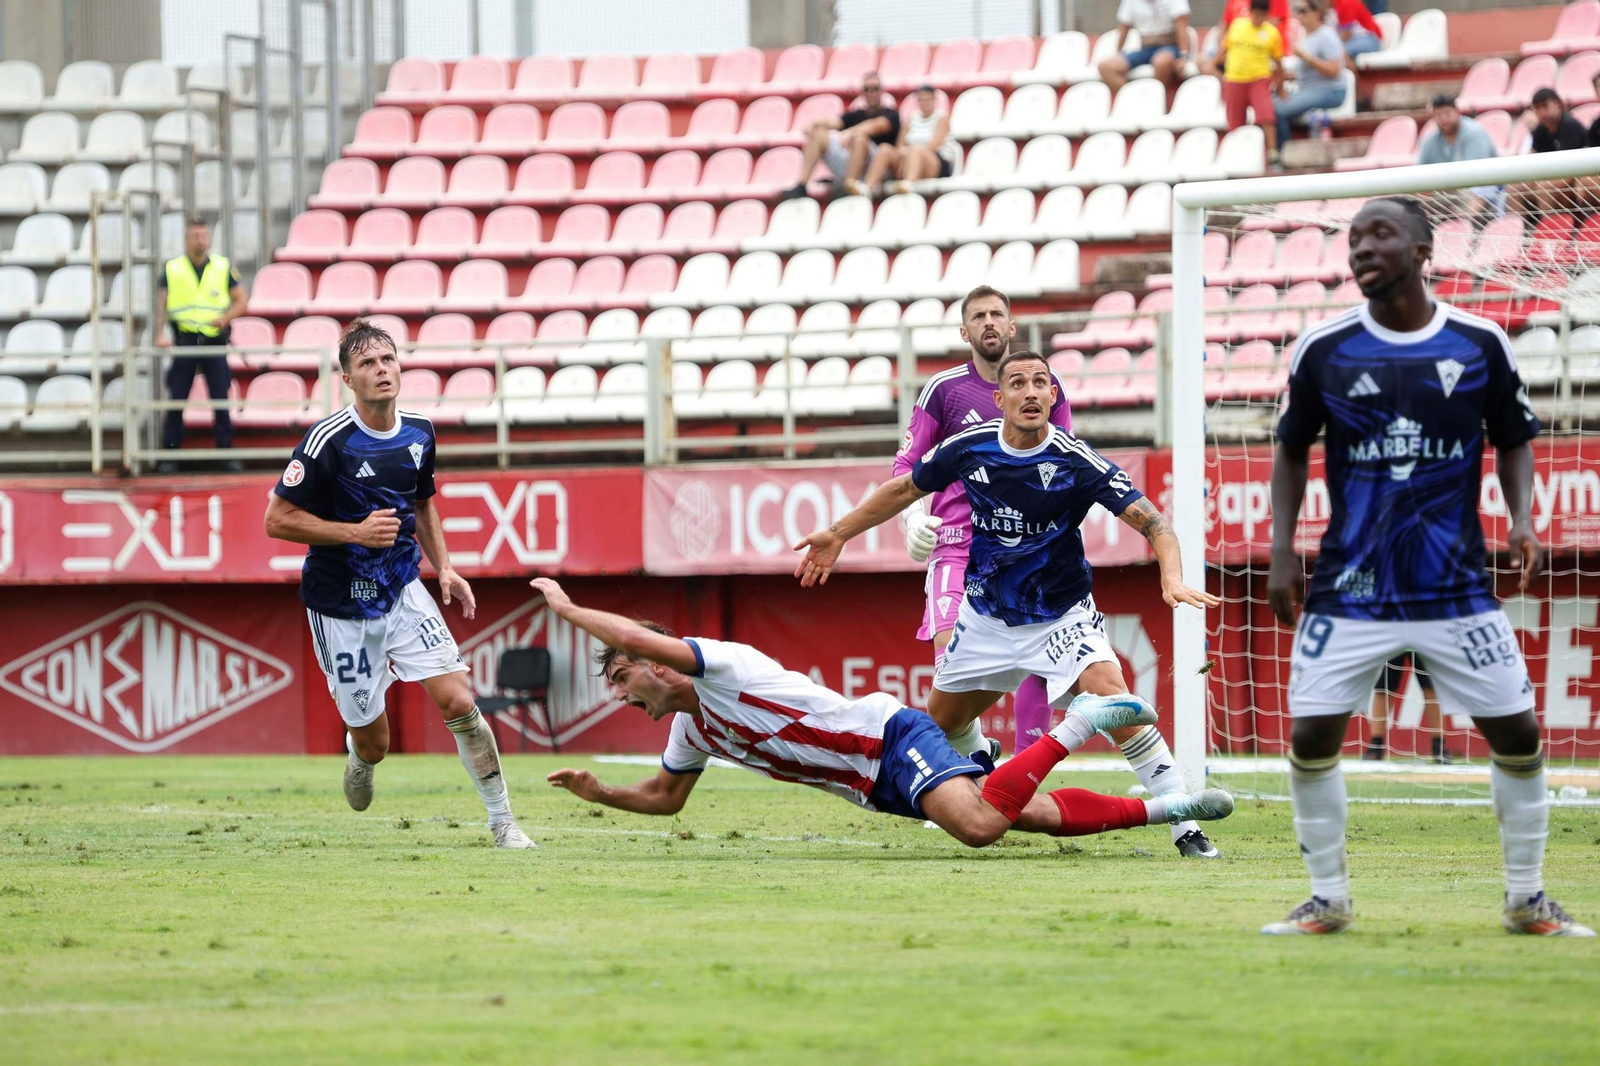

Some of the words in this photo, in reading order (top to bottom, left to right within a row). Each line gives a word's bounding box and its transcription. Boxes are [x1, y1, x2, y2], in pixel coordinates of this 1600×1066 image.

[1349, 436, 1465, 462] MARBELLA
[441, 480, 568, 565] EXO
[970, 510, 1059, 535] MARBELLA
[350, 587, 378, 602] laga
[419, 628, 453, 650] lag
[336, 647, 372, 684] 24
[1462, 641, 1520, 671] lag
[842, 656, 936, 708] ESQ
